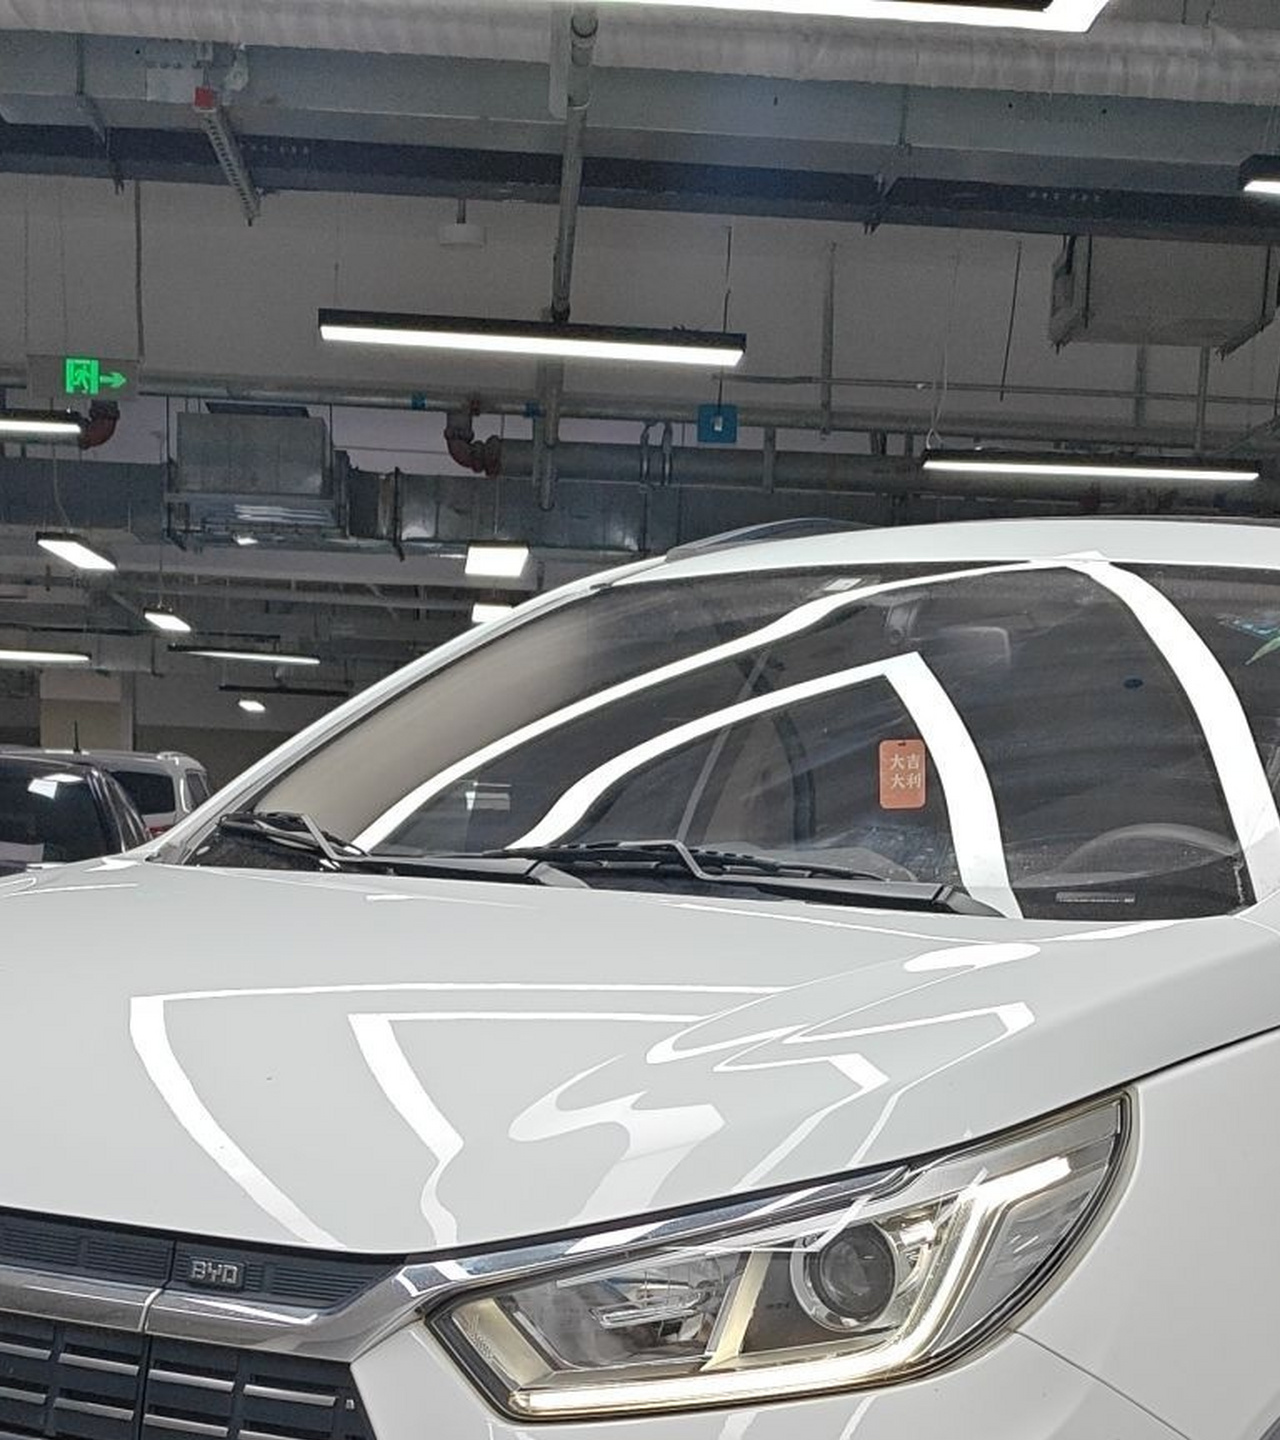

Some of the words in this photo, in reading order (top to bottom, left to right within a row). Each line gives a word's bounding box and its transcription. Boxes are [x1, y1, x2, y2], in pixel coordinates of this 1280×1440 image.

[890, 753, 920, 770] 大吉
[890, 773, 921, 789] 大利
[190, 1260, 238, 1284] BYD
